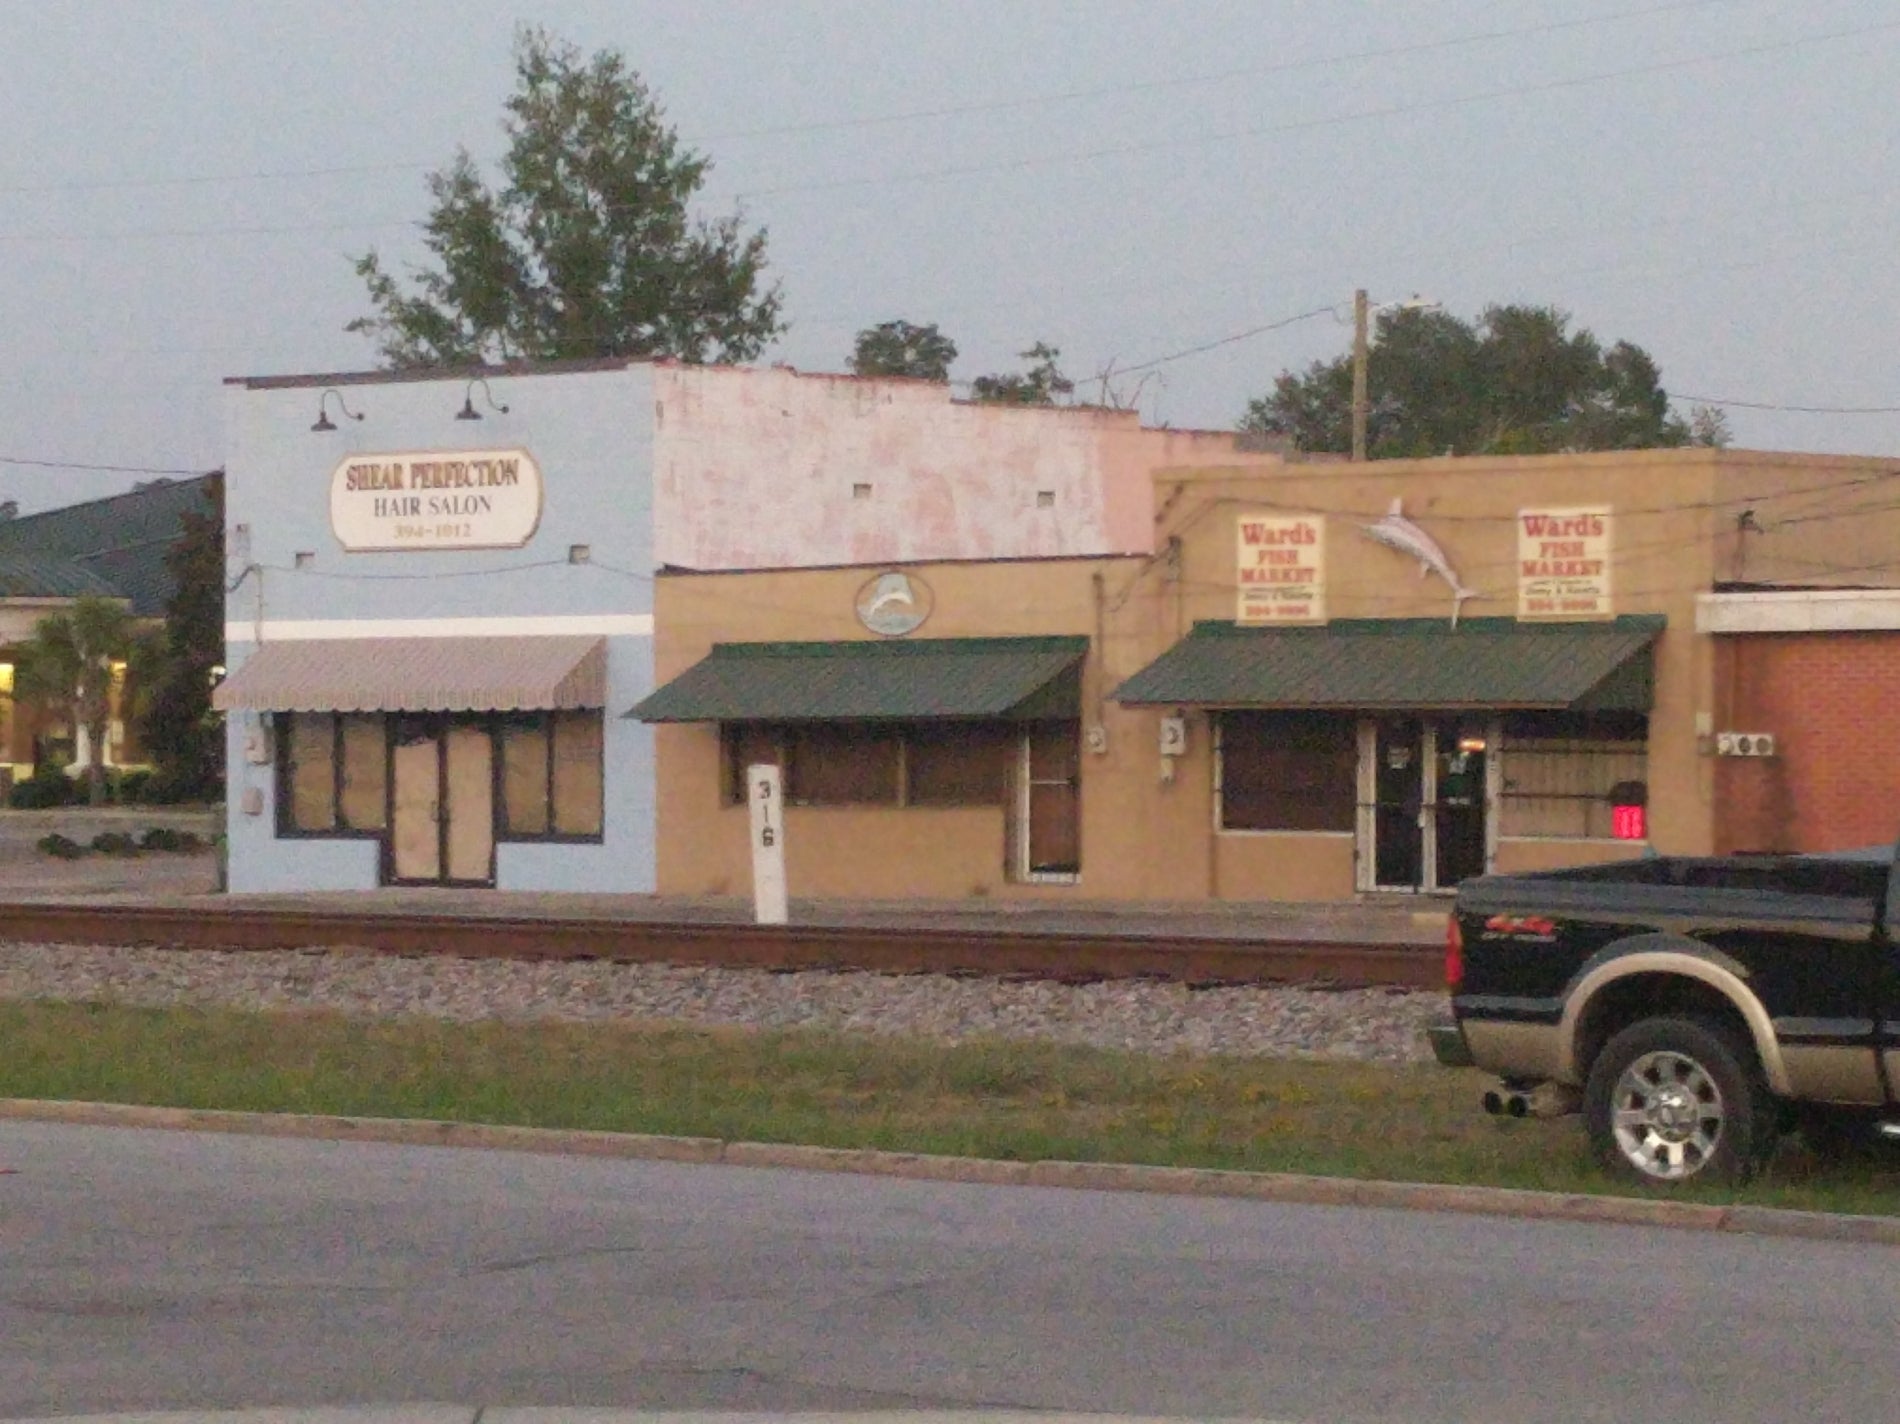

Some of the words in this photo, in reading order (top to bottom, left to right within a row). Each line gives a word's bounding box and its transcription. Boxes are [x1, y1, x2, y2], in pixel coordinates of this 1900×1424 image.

[346, 463, 403, 491] SHEAR
[410, 459, 520, 489] PERFECTION
[374, 497, 420, 517] HAIR
[428, 496, 492, 516] SALON
[1240, 567, 1315, 583] MARKET
[1522, 560, 1603, 577] MARKET
